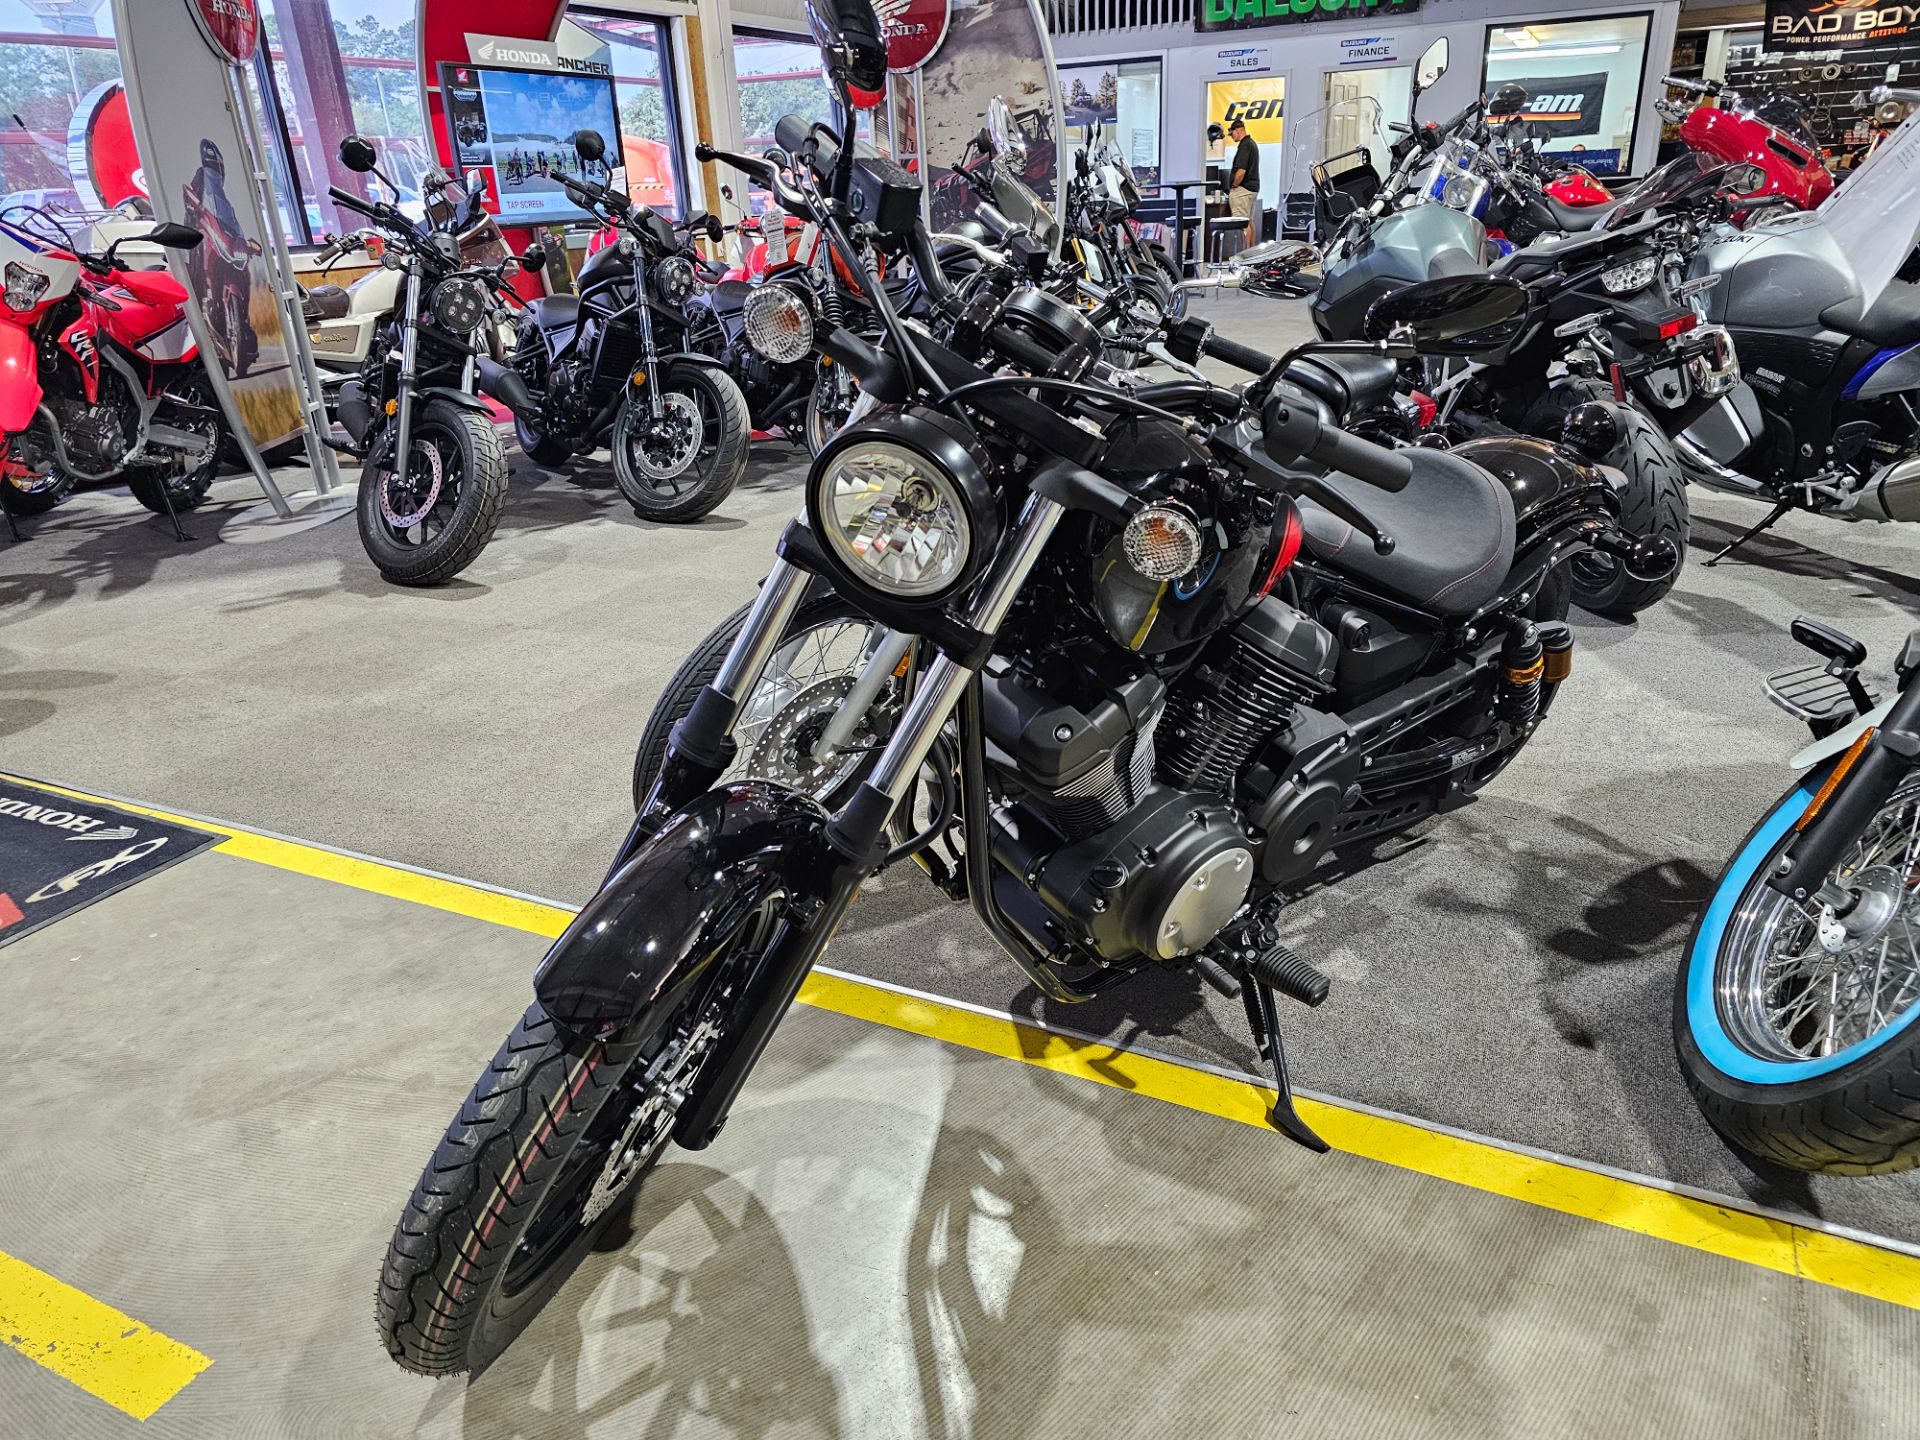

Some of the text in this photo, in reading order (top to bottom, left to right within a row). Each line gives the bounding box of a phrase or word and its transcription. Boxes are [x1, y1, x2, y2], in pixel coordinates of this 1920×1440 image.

[212, 0, 253, 21] HONDA
[1772, 6, 1920, 34] BAD BOY
[880, 23, 928, 38] ONDA
[1868, 26, 1909, 39] ATTITUDE
[495, 48, 553, 65] HONDA
[1348, 46, 1390, 58] FINANCE
[557, 56, 609, 75] ANCHER
[1230, 57, 1259, 67] SALES
[1524, 93, 1585, 113] -am
[507, 201, 519, 209] TAP
[519, 200, 545, 209] SCREEN
[0, 797, 106, 833] HOND
